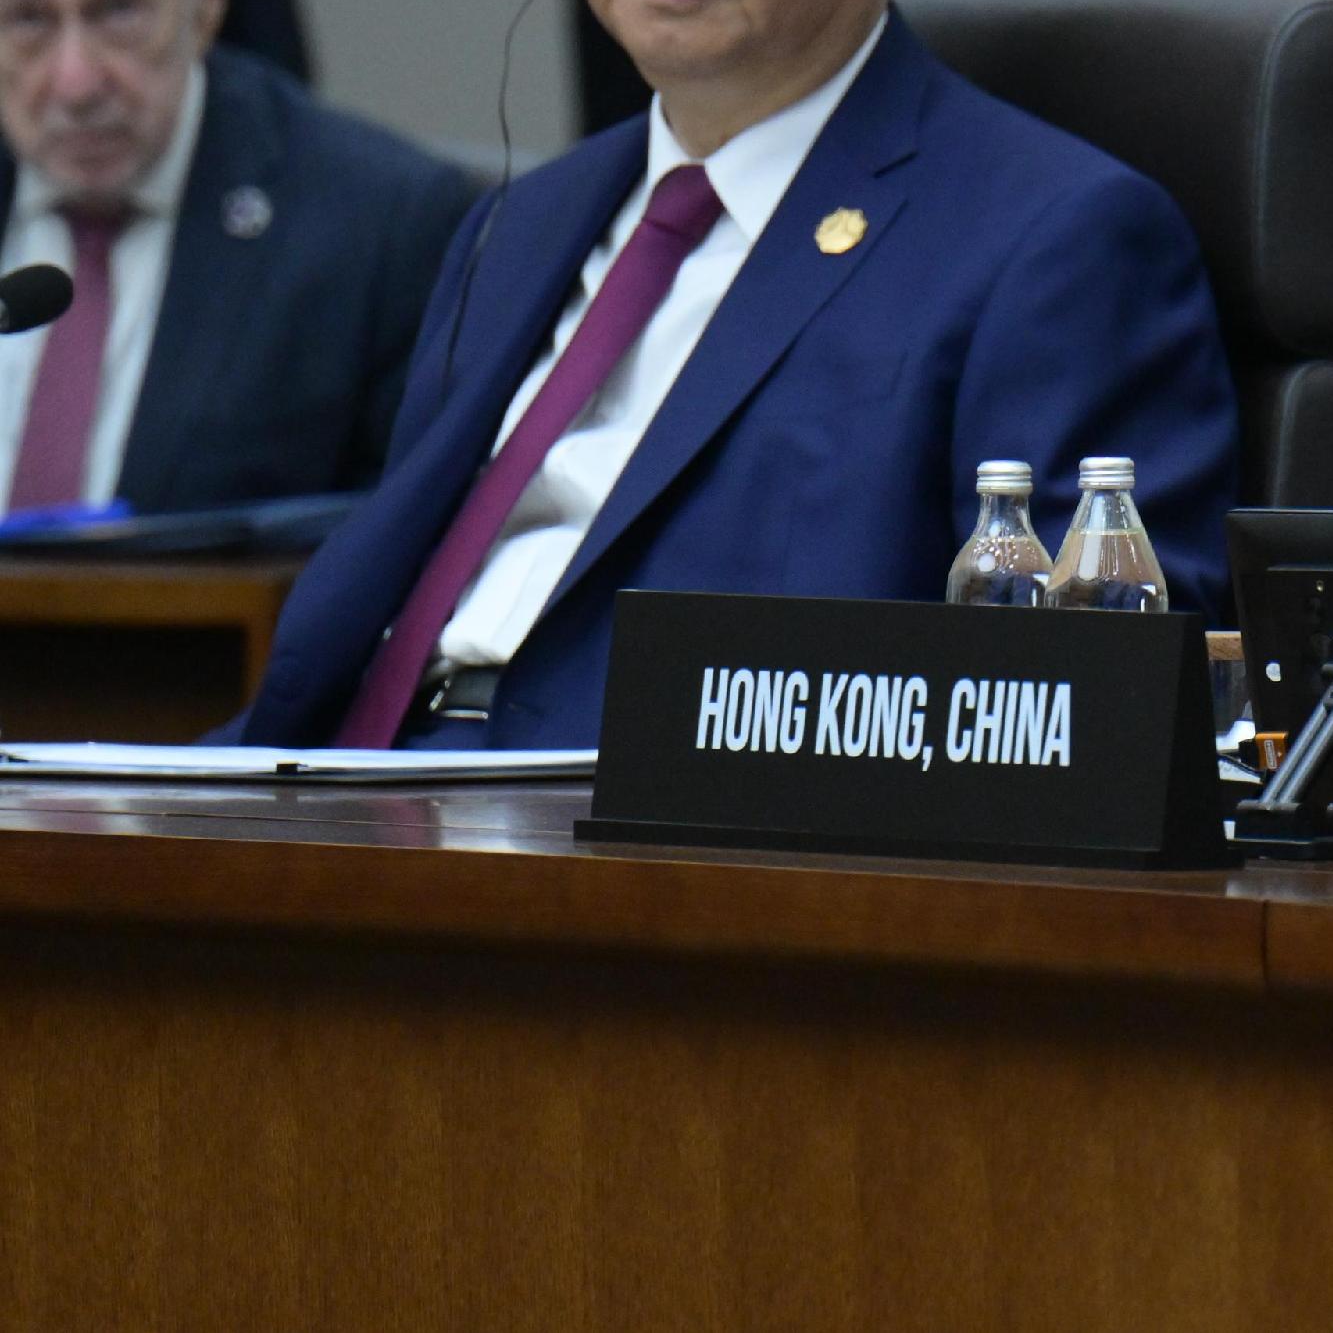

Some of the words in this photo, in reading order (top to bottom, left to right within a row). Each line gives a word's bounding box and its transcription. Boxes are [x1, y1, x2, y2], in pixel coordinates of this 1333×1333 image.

[696, 667, 809, 754] HONG
[814, 673, 933, 772] KONG,
[946, 678, 1071, 767] CHINA
